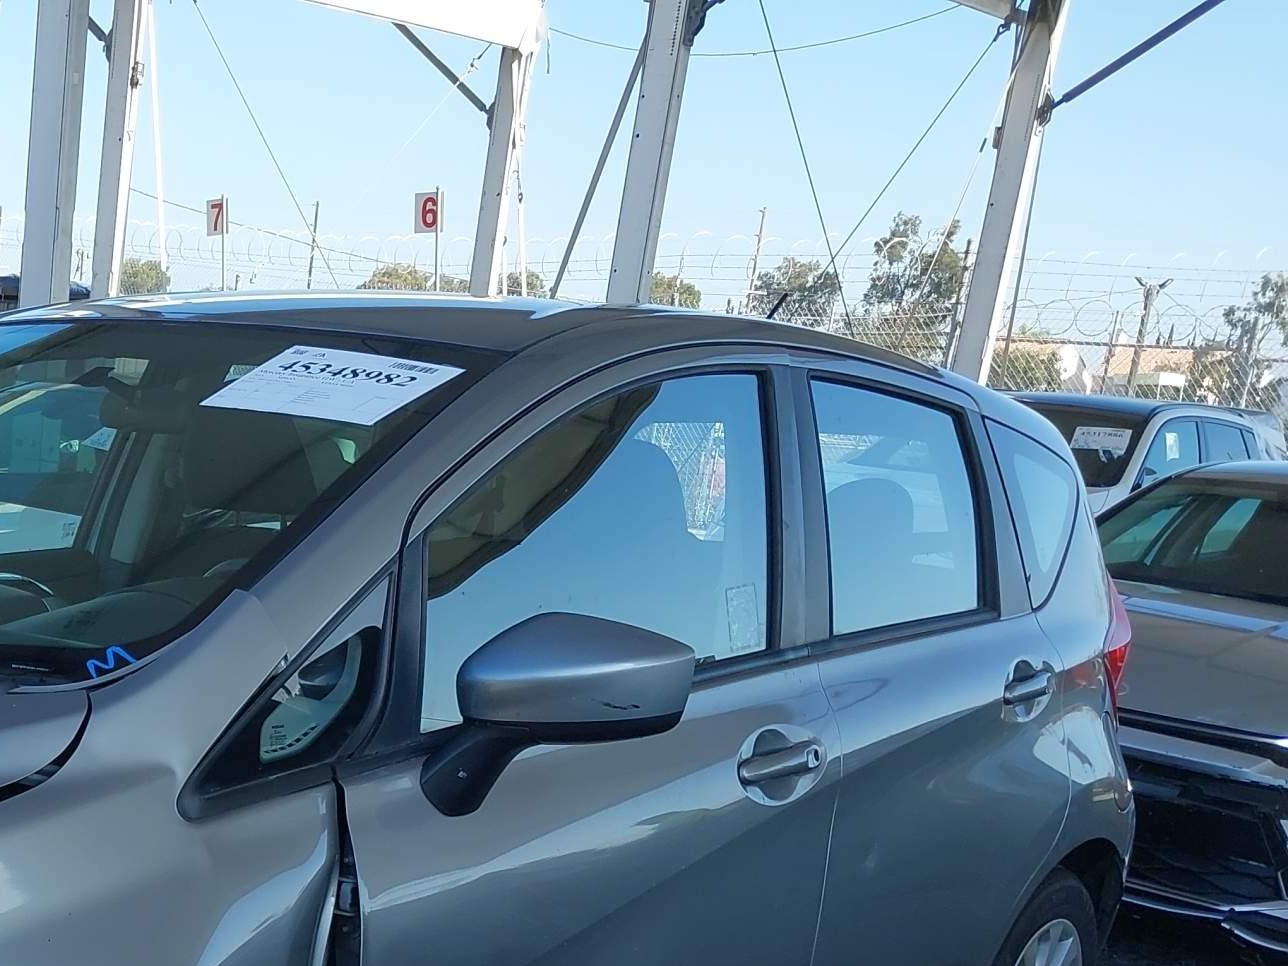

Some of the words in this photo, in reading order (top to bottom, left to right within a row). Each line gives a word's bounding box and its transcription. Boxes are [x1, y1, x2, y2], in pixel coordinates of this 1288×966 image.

[210, 202, 223, 232] 7
[421, 196, 437, 228] 6
[278, 360, 417, 387] 45348982
[86, 645, 136, 679] M
